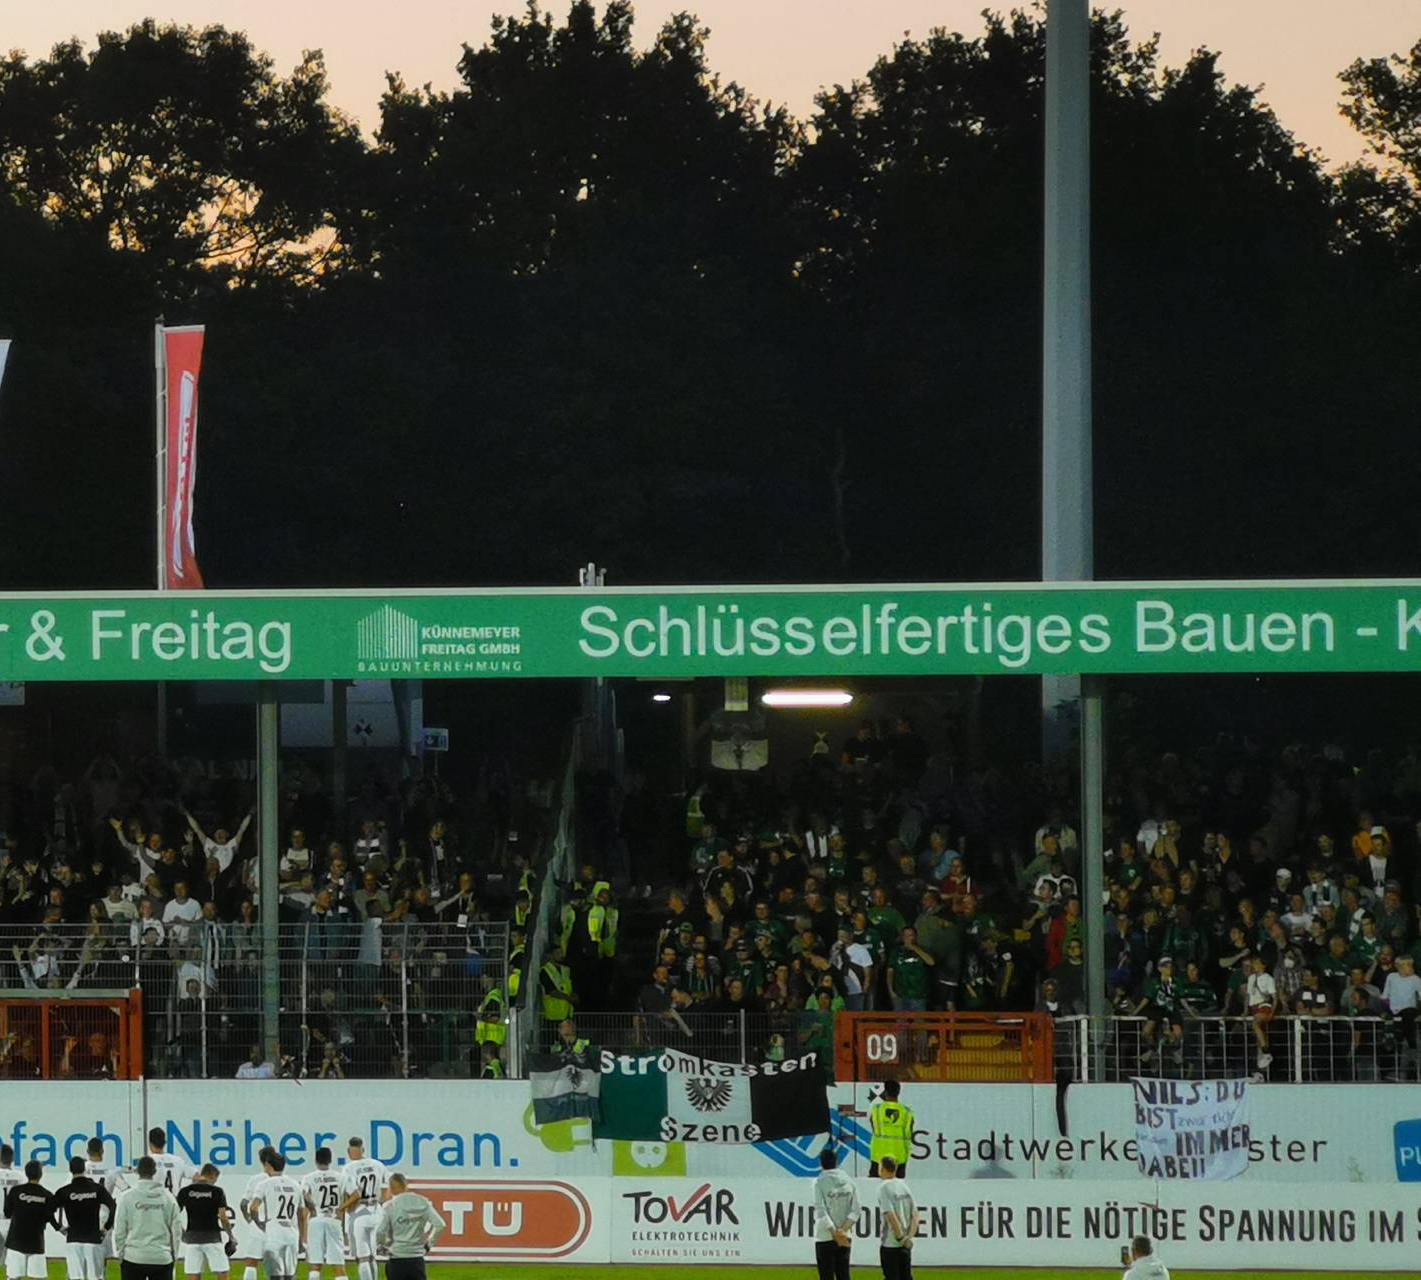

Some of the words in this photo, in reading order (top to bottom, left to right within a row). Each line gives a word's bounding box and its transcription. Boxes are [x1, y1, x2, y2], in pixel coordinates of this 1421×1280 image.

[25, 609, 66, 662] &
[91, 609, 292, 673] Freitag
[422, 625, 521, 639] KÜNNEMEYER
[579, 602, 1111, 668] Schlüsselfertiges
[1136, 599, 1334, 652] Bauen
[422, 643, 475, 655] FREITAG
[479, 643, 521, 655] GMBH
[357, 660, 522, 672] BAUUNTERNEHMUNG
[867, 1033, 897, 1061] 09
[600, 1049, 818, 1078] Stromkasten
[1216, 1080, 1247, 1103] DU
[659, 1116, 762, 1143] Szene
[1134, 1103, 1178, 1131] BIST
[370, 1119, 520, 1168] Dran.
[910, 1130, 1139, 1162] Stadtwerke
[1247, 1133, 1328, 1162] ster
[1175, 1123, 1251, 1158] IMMER
[277, 1195, 295, 1219] 26
[318, 1184, 338, 1209] 25
[960, 1200, 1014, 1239] FÜR
[1026, 1206, 1073, 1240] DIE
[1084, 1202, 1187, 1241] NÖTIGE
[1198, 1205, 1356, 1243] SPANNUNG
[1368, 1209, 1405, 1243] IM
[631, 1231, 741, 1242] ELEKTROTECHNIK
